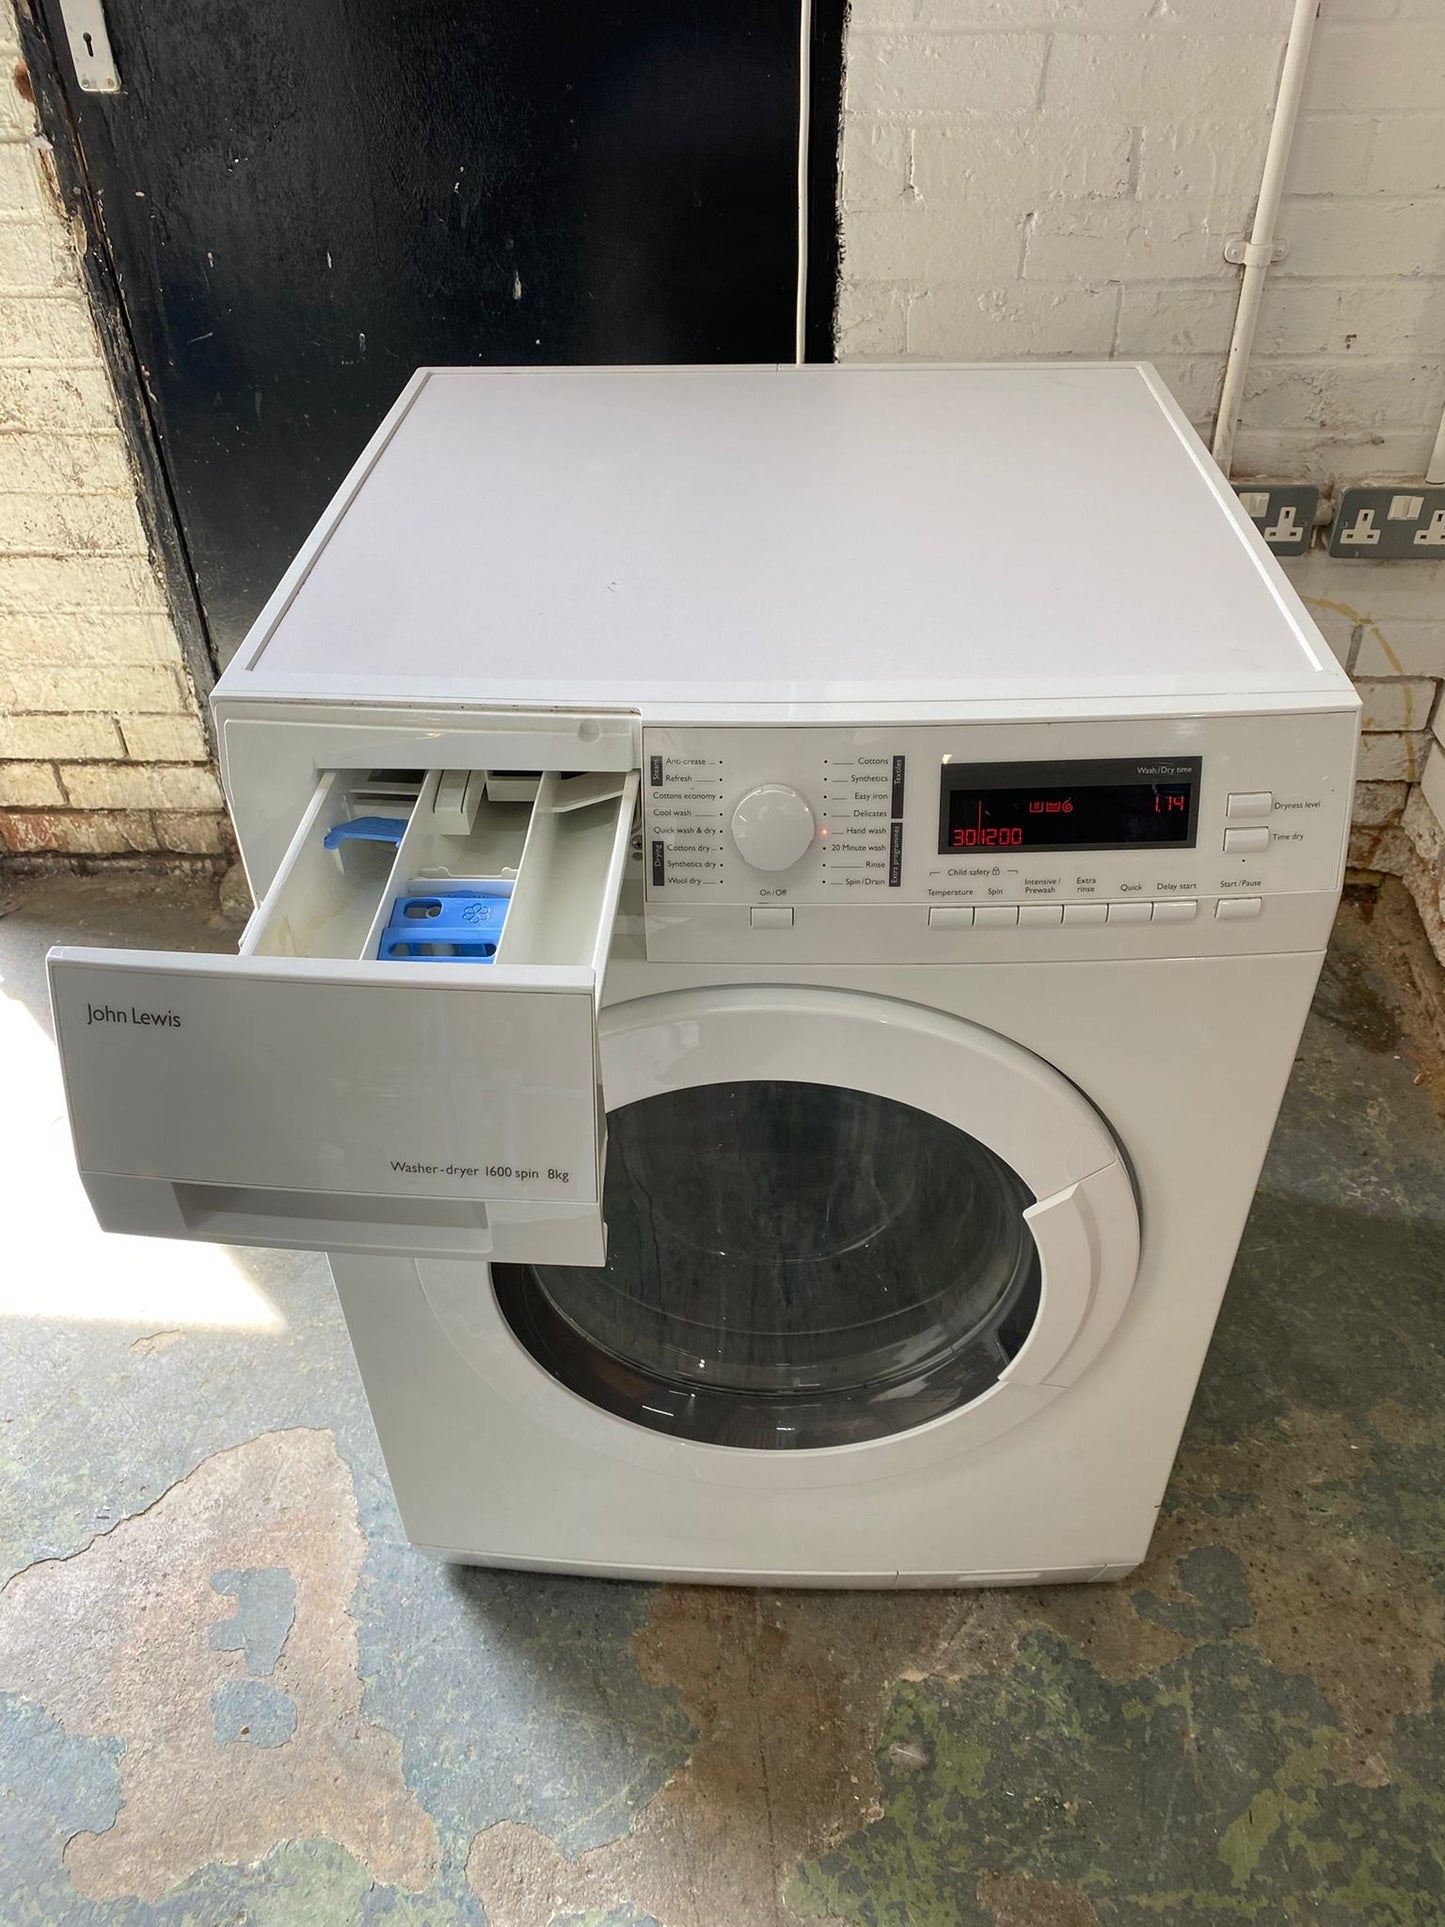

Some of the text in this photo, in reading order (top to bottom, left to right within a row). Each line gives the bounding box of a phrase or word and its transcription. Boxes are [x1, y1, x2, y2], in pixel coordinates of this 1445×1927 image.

[858, 757, 889, 765] Cottons
[653, 792, 682, 800] Cottons
[1275, 800, 1321, 810] Dryness level
[854, 809, 887, 817] Delicates
[704, 827, 716, 835] dry
[1273, 833, 1303, 842] Time dry
[667, 844, 696, 852] Cottons
[668, 861, 716, 869] Synthetics dry
[948, 868, 990, 877] Child safety
[689, 877, 701, 885] dry
[1077, 877, 1096, 885] Extra
[1025, 886, 1056, 894] Prewash
[1077, 885, 1095, 893] rinse
[1120, 883, 1142, 892] Quick
[1157, 882, 1197, 892] Delay start
[928, 889, 973, 898] Temperature
[988, 888, 1003, 897] Spin
[87, 1003, 181, 1028] John Lewis
[485, 1166, 512, 1179] 1600
[515, 1167, 539, 1181] spin
[547, 1169, 570, 1183] 8kg
